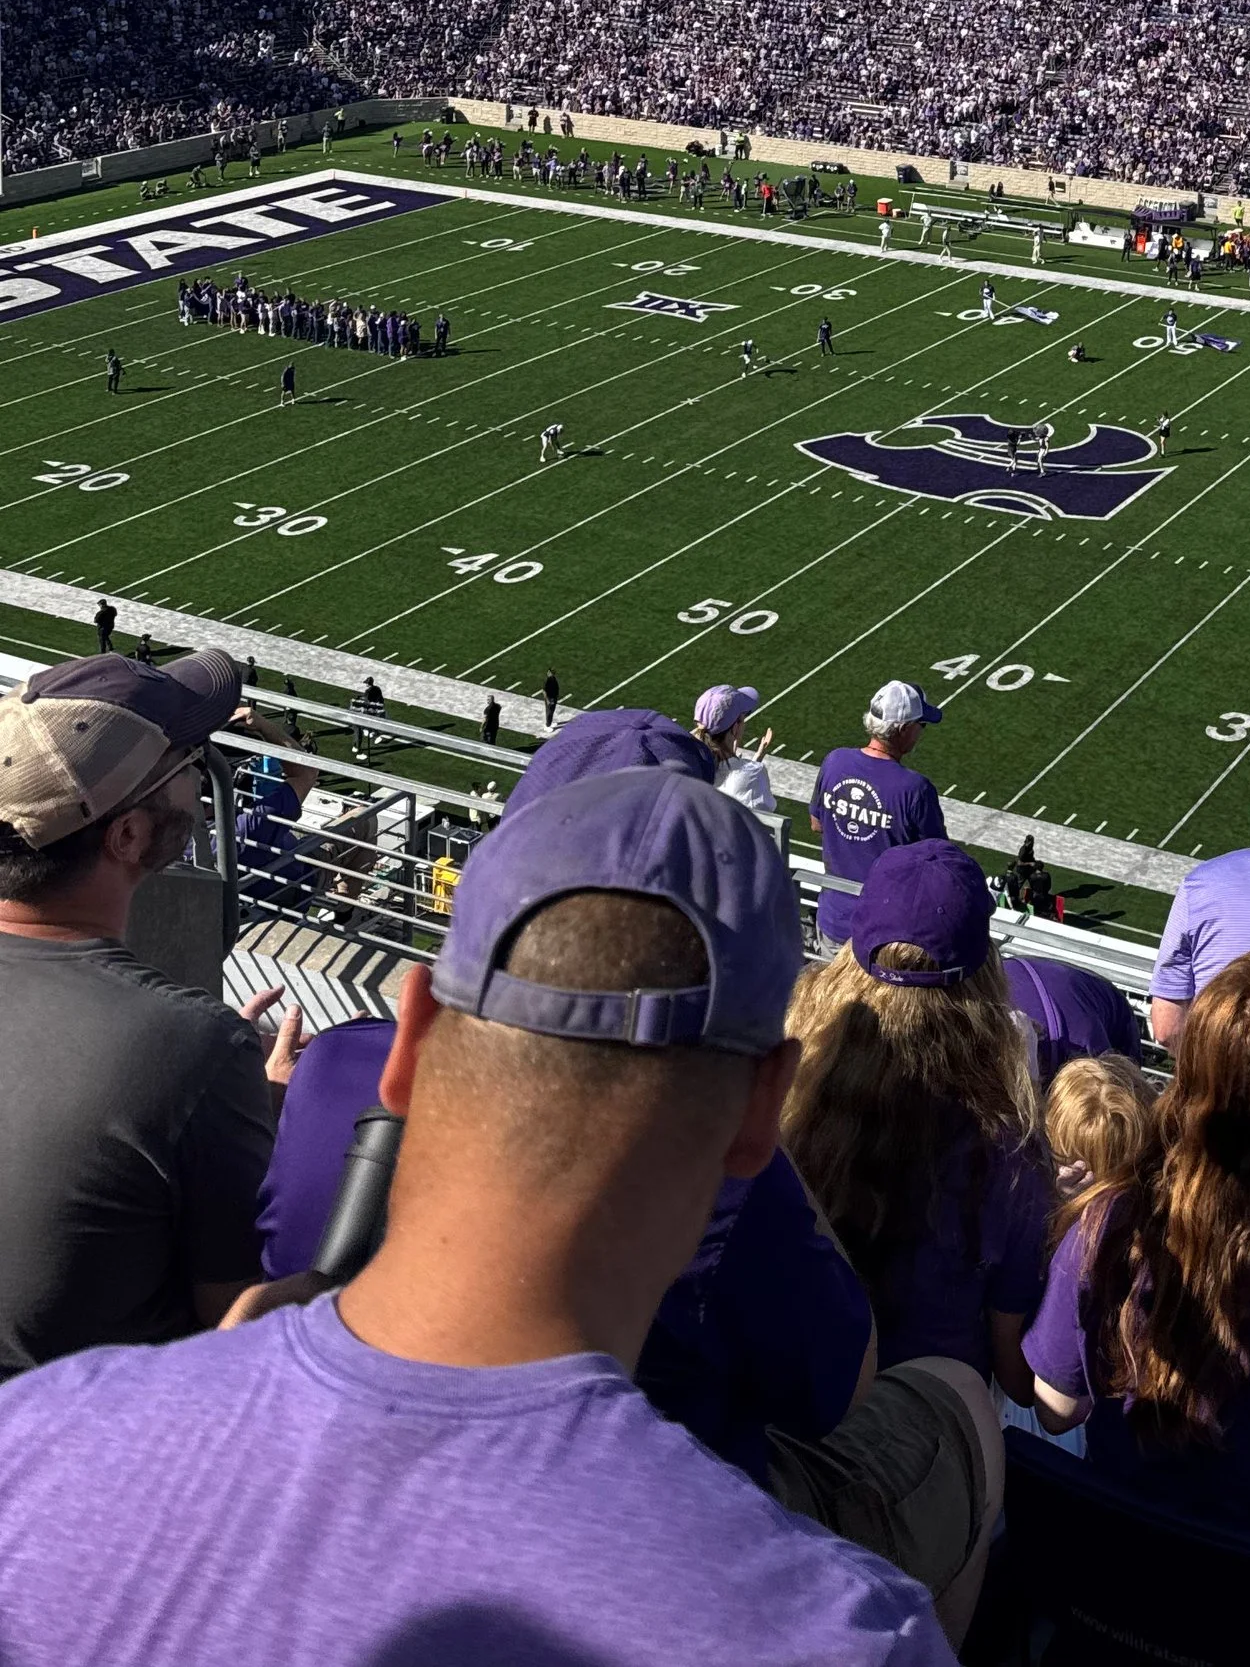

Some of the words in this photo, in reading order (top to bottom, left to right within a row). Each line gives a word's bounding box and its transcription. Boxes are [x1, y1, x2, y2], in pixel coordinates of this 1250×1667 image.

[480, 238, 534, 251] 10
[630, 260, 702, 276] 20
[789, 283, 857, 301] 30
[1133, 336, 1203, 355] 50
[32, 463, 131, 491] 20
[233, 506, 329, 537] 30
[447, 552, 545, 584] 40
[677, 598, 780, 634] 50
[930, 653, 1036, 692] 40
